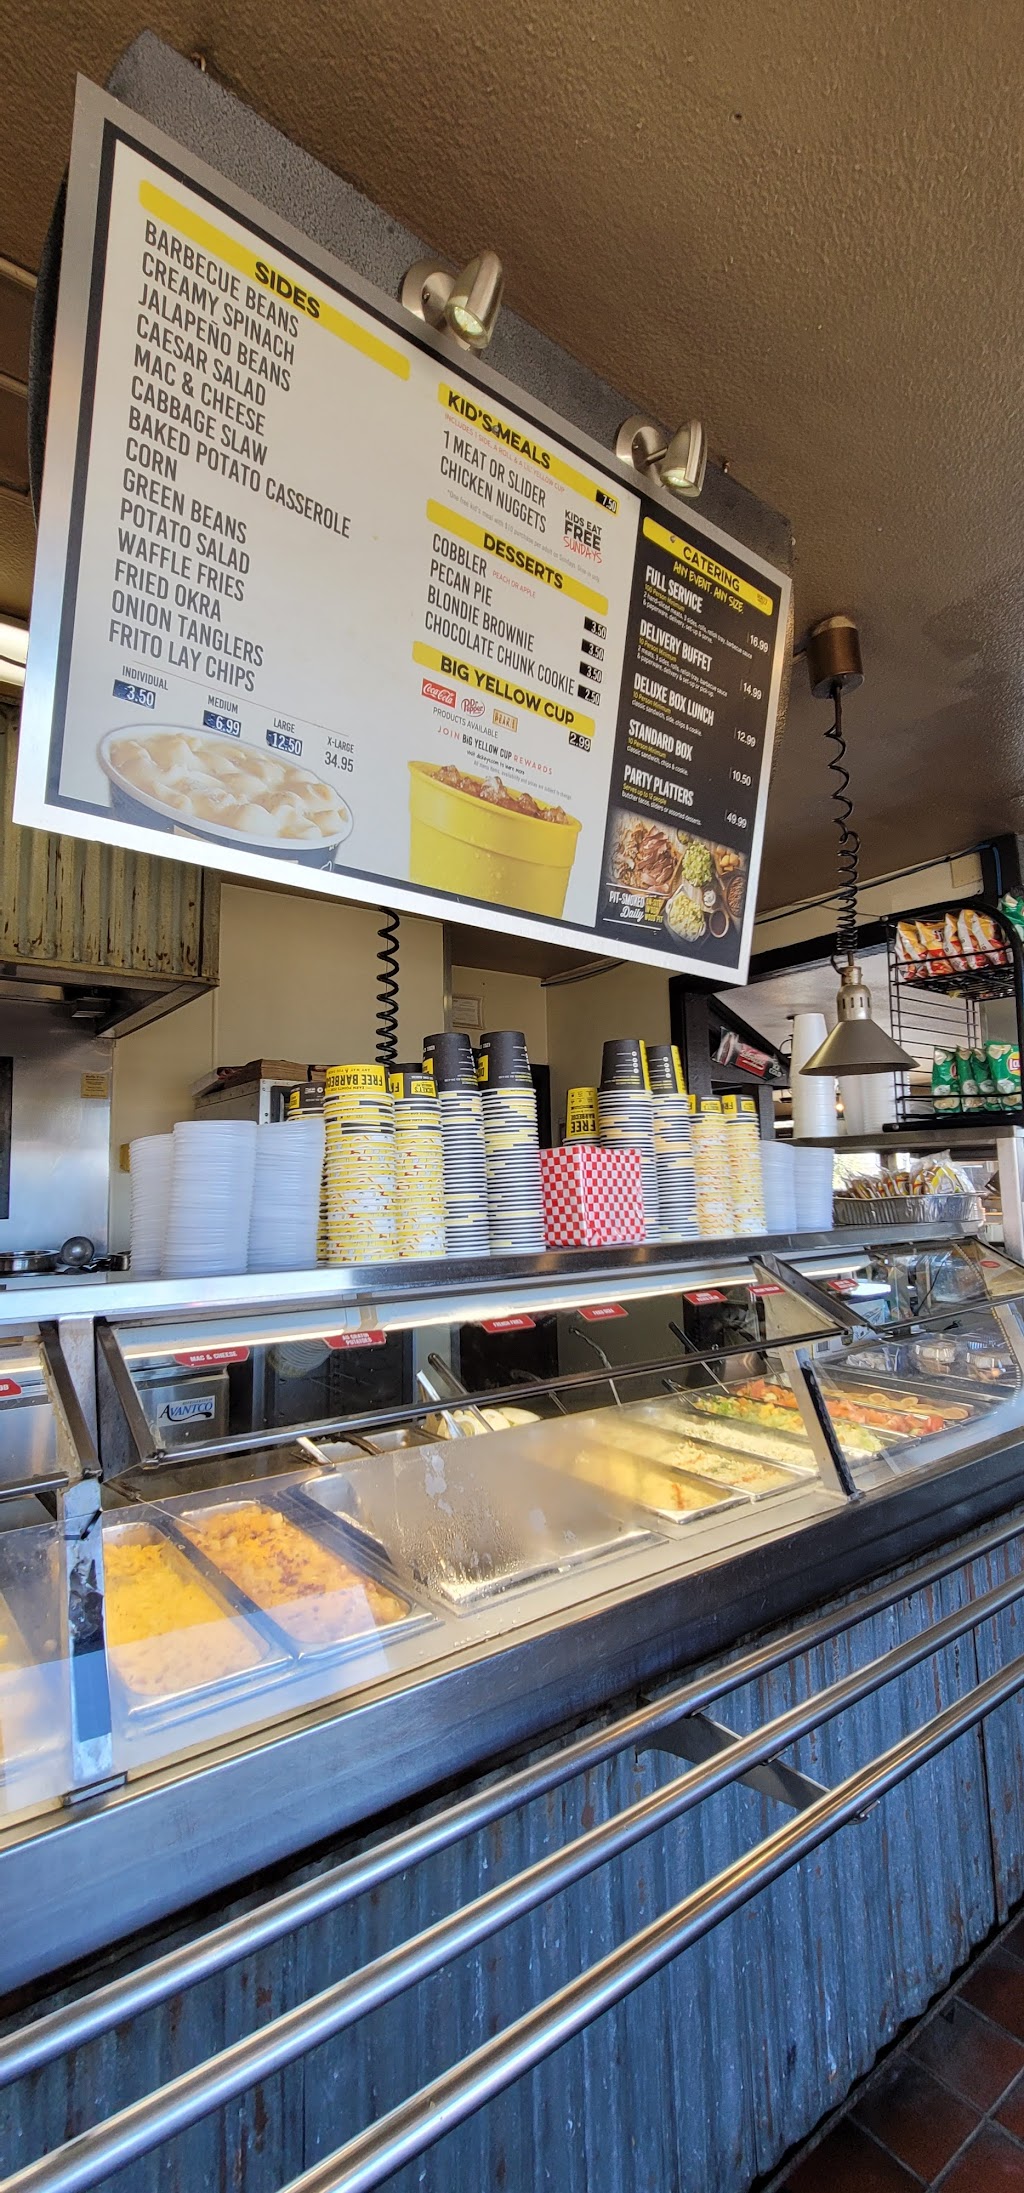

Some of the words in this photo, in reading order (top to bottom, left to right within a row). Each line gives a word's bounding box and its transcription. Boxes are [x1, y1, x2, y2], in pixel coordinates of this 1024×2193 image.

[145, 219, 241, 302] BARBECUE
[245, 285, 299, 338] BEANS
[255, 261, 320, 319] SIDES
[142, 251, 219, 316] CREAMY
[222, 302, 295, 366] SPINACH
[138, 283, 232, 356] JALAPEÑO
[237, 341, 291, 392] BEANS
[136, 313, 208, 375] CAESAR
[212, 358, 266, 406] SALAD
[134, 343, 176, 387] MAC
[181, 371, 195, 399] &
[201, 382, 266, 437] CHEESE
[131, 375, 217, 440] CABBAGE
[220, 423, 268, 466] SLAW
[126, 437, 178, 482] CORN
[444, 413, 474, 436] INCLUDES
[533, 470, 554, 486] YELLOW
[554, 482, 565, 493] CUP
[496, 422, 551, 470] MEALS
[128, 405, 190, 456] BAKED
[196, 440, 261, 492] POTATO
[265, 477, 351, 539] CASSEROLE
[443, 430, 450, 449] 1
[453, 435, 487, 471] MEAT
[489, 458, 505, 483] OR
[507, 470, 546, 508] SLIDER
[123, 467, 185, 516] GREEN
[190, 499, 247, 544] BEANS
[440, 455, 493, 502] CHICKEN
[496, 488, 547, 533] NUGGETS
[603, 495, 617, 513] 7.50
[120, 497, 191, 549] POTATO
[196, 532, 250, 574] SALAD
[564, 519, 601, 552] FREE
[565, 509, 585, 527] KIDS
[586, 521, 602, 535] EAT
[483, 532, 563, 589] DESSERTS
[563, 529, 602, 564] SUNDAYS
[118, 527, 192, 580] WAFFLE
[197, 562, 245, 602] FRIES
[432, 533, 487, 578] COBBLER
[492, 569, 511, 585] PEACH
[511, 580, 519, 589] OR
[519, 585, 536, 599] APPLE
[673, 561, 689, 578] ANY
[713, 586, 728, 603] ANY
[683, 546, 740, 592] CATERING
[114, 558, 169, 600] FRIED
[174, 583, 221, 623] OKRA
[430, 558, 471, 595] PECAN
[473, 581, 493, 607] PIE
[645, 565, 667, 593] FULL
[667, 579, 703, 614] SERVICE
[652, 588, 667, 601] Person
[667, 597, 685, 612] Minimum
[112, 589, 172, 633] ONION
[177, 614, 264, 667] TANGLERS
[427, 584, 480, 626] BLONDIE
[482, 611, 535, 653] BROWNIE
[591, 621, 607, 639] 3.50
[109, 618, 163, 659] FRITO
[168, 641, 202, 672] LAY
[205, 655, 255, 692] CHIPS
[425, 610, 495, 659] CHOCOLATE
[497, 645, 535, 678] CHUNK
[537, 664, 575, 696] COOKIE
[589, 643, 604, 661] 3.50
[639, 619, 682, 655] DELIVERY
[681, 642, 713, 672] BUFFET
[644, 640, 659, 653] Person
[658, 648, 677, 663] Minimum
[750, 633, 769, 654] 16.99
[122, 665, 169, 691] INDIVIDUAL
[440, 655, 469, 682] BIG
[474, 669, 541, 712] YELLOW
[544, 702, 574, 725] CUP
[587, 665, 603, 683] 3.50
[743, 681, 762, 701] 14.99
[127, 685, 155, 707] 3.50
[207, 694, 238, 714] MEDIUM
[585, 688, 601, 705] 2.50
[633, 672, 668, 704] DELUXE
[668, 690, 687, 713] BOX
[687, 699, 715, 726] LUNCH
[638, 693, 653, 706] Person
[652, 700, 672, 714] Minimum
[216, 715, 241, 736] 6.99
[273, 717, 296, 734] LARGE
[432, 706, 466, 726] PRODUCTS
[466, 720, 498, 739] AVAILABLE
[628, 718, 675, 753] STANDARD
[675, 739, 693, 762] BOX
[737, 729, 757, 747] 12.99
[327, 736, 355, 754] X-LARGE
[437, 725, 460, 740] JOIN
[474, 738, 499, 755] YELLOW
[499, 748, 512, 760] CUP
[513, 754, 552, 775] REWARDS
[570, 732, 592, 752] 2.99
[633, 739, 648, 751] Person
[647, 745, 667, 759] Minimum
[324, 751, 355, 773] 34.95
[733, 769, 752, 787] 10.50
[623, 764, 654, 790] PARTY
[653, 776, 694, 807] PLATTERS
[623, 782, 637, 794] Serves
[652, 795, 667, 805] people
[727, 811, 748, 829] 49.99
[609, 891, 644, 908] PIT-SMOKED
[620, 906, 644, 922] Daily
[361, 1074, 383, 1086] FREE
[571, 1119, 596, 1133] FREE
[190, 1354, 205, 1362] MAC
[213, 1350, 238, 1359] CHEESE
[346, 1337, 373, 1346] POTATOES
[159, 1401, 213, 1420] AVANTCO
